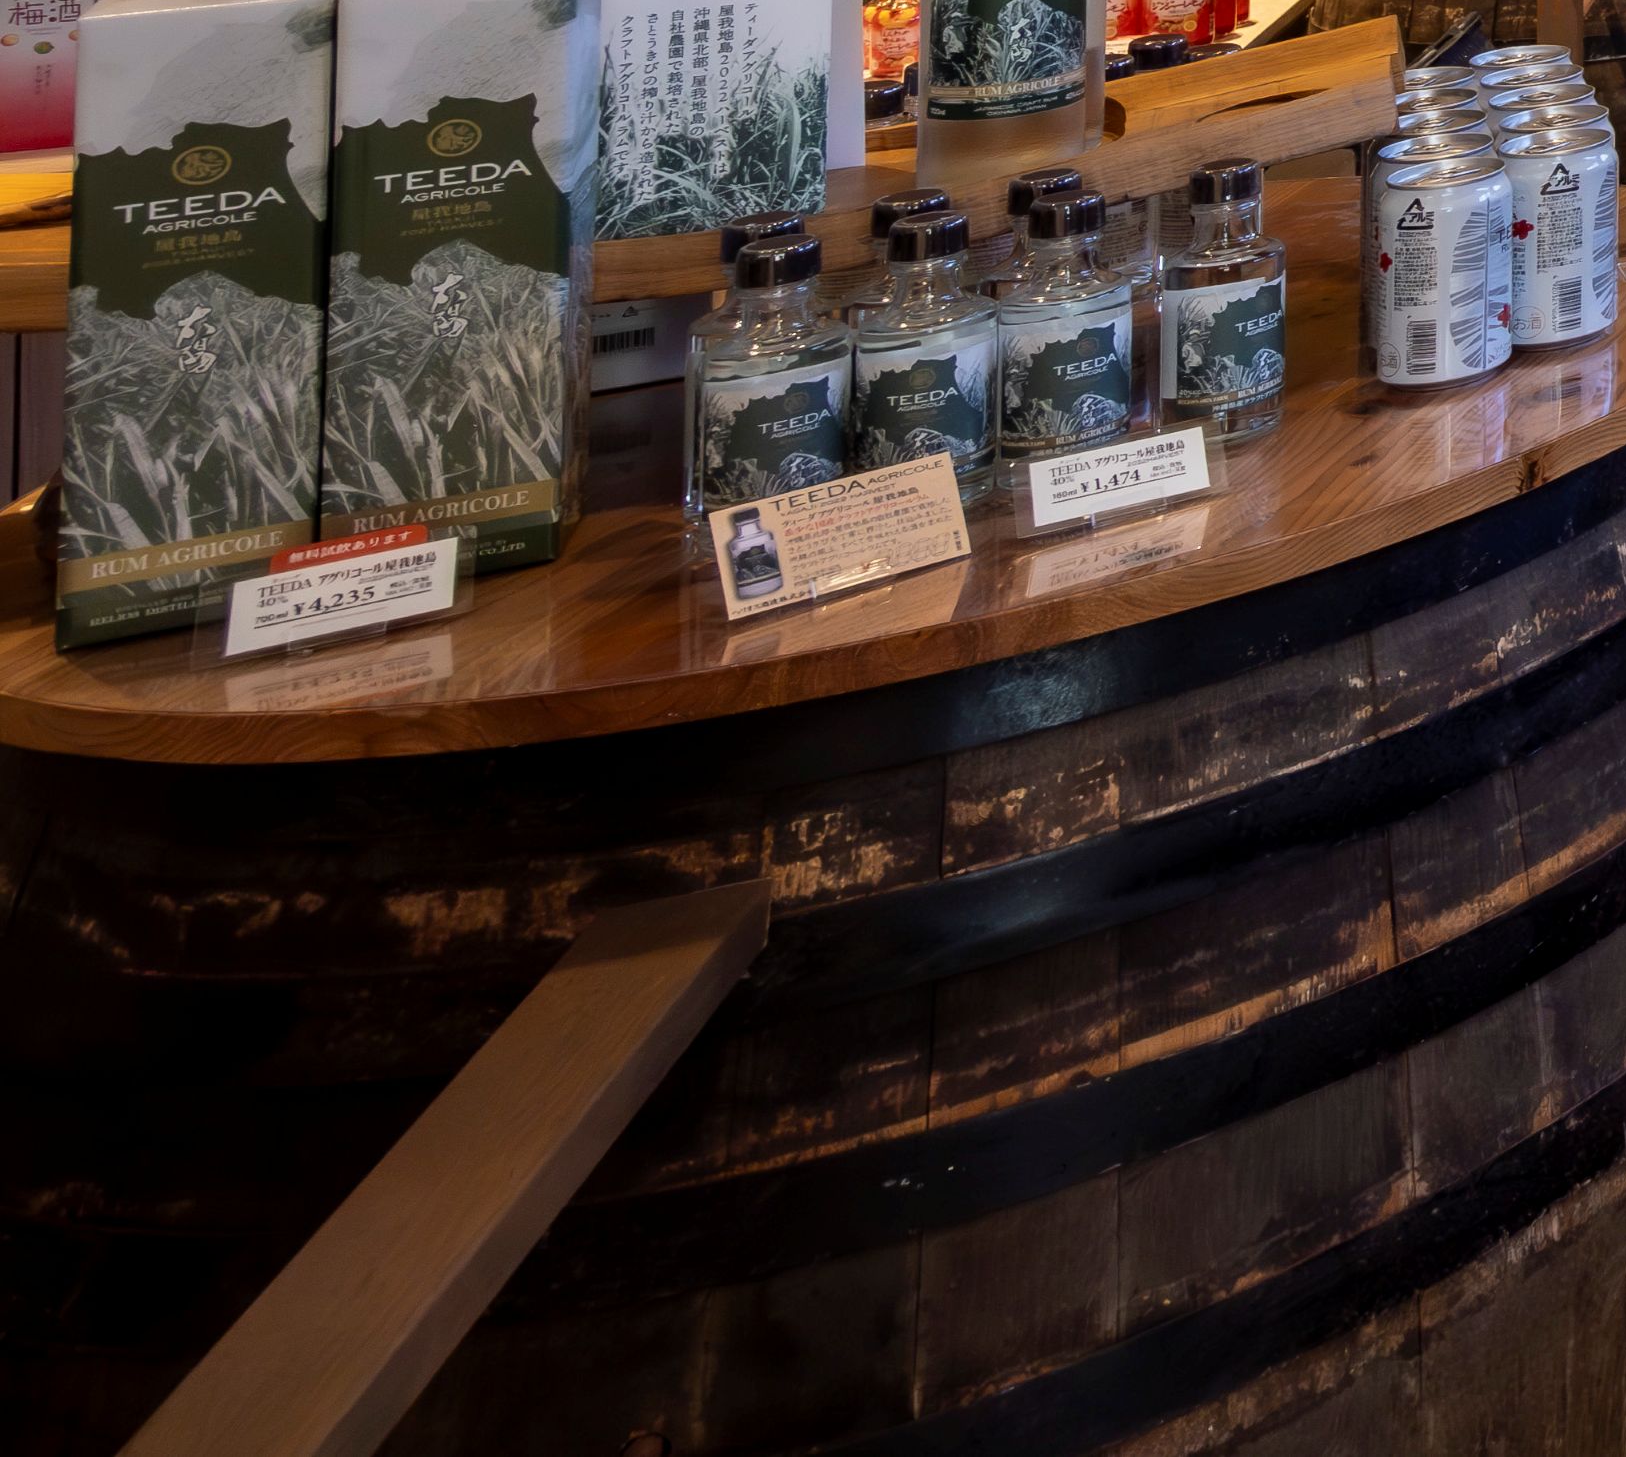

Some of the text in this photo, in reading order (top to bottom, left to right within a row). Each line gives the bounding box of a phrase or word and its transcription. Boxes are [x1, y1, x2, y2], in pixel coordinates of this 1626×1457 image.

[665, 9, 685, 134] 自社農園で栽培された
[690, 7, 710, 136] 沖縄県北部、屋我地島の
[738, 2, 759, 119] ティーダアグリコール
[1003, 76, 1061, 96] AGRICOLE
[637, 13, 659, 202] さとうきびの搾り汁から造られた
[374, 159, 533, 193] TEEDA
[113, 186, 286, 224] TEEDA
[400, 182, 506, 204] AGRICOLE
[142, 211, 258, 235] AGRICOLE
[1235, 309, 1283, 333] TEEDA
[1053, 354, 1117, 376] TEEDA
[1065, 366, 1109, 381] AGRICOLE
[886, 386, 959, 407] TEEDA
[896, 400, 947, 413] AGRICOLE
[757, 408, 832, 434] TEEDA
[770, 423, 821, 439] AGRICOLE
[1056, 434, 1077, 446] RUM
[1048, 439, 1184, 478] TEEDA アグリコール屋我地島
[768, 459, 944, 512] TEEDA AGRICOLE
[353, 490, 530, 534] RUM AGRICOLE
[91, 530, 285, 579] RUM AGRICOLE
[257, 578, 312, 598] TEEDA
